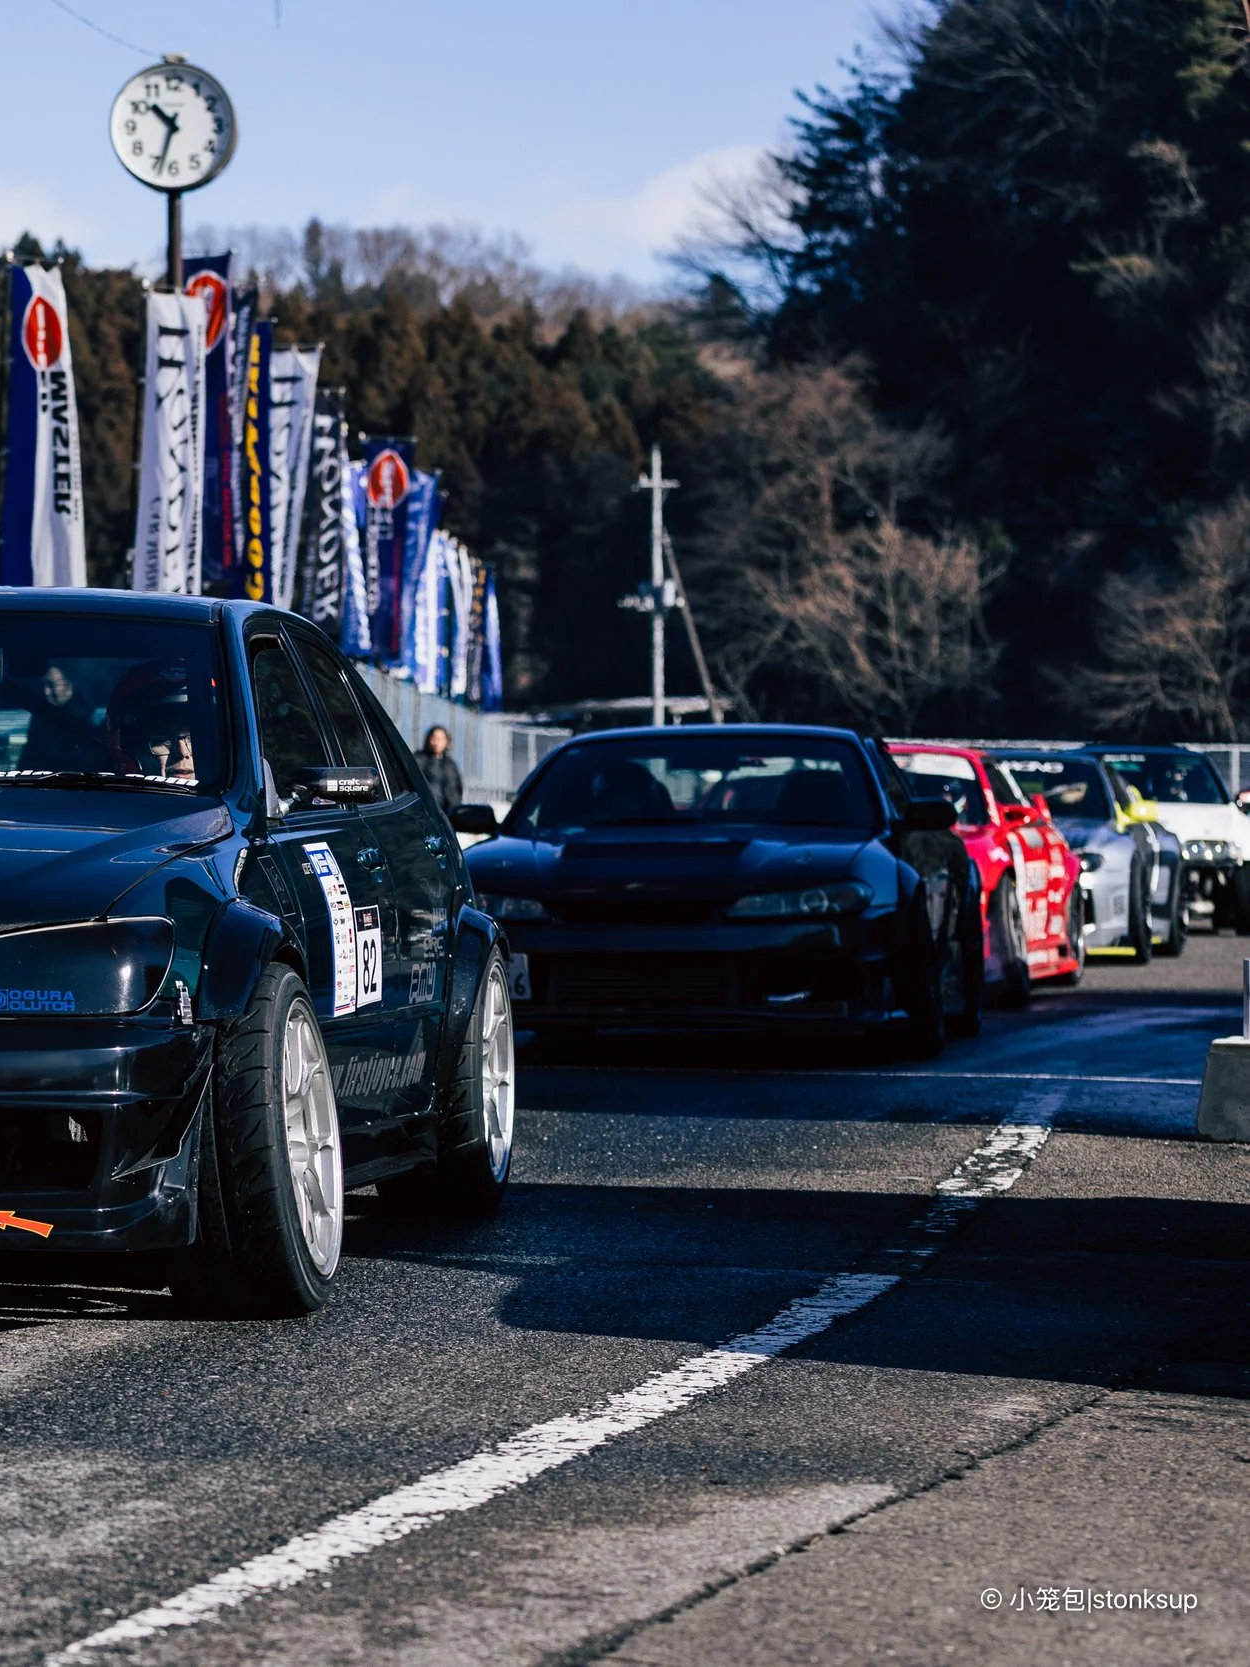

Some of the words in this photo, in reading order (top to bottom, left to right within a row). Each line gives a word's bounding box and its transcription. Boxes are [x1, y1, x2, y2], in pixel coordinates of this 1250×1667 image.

[166, 75, 183, 92] 12
[192, 83, 201, 96] 1
[145, 84, 160, 98] 11
[130, 101, 148, 115] 10
[206, 96, 216, 112] 2
[125, 120, 137, 135] 9
[213, 118, 224, 134] 3
[132, 142, 143, 156] 8
[204, 140, 215, 154] 4
[150, 156, 161, 170] 7
[167, 160, 179, 176] 6
[190, 155, 200, 169] 5
[339, 778, 361, 786] craft
[339, 785, 369, 793] square
[423, 936, 444, 953] ORC
[363, 939, 377, 995] 82
[9, 990, 75, 1000] OGURA
[9, 1001, 75, 1012] CLUTCH
